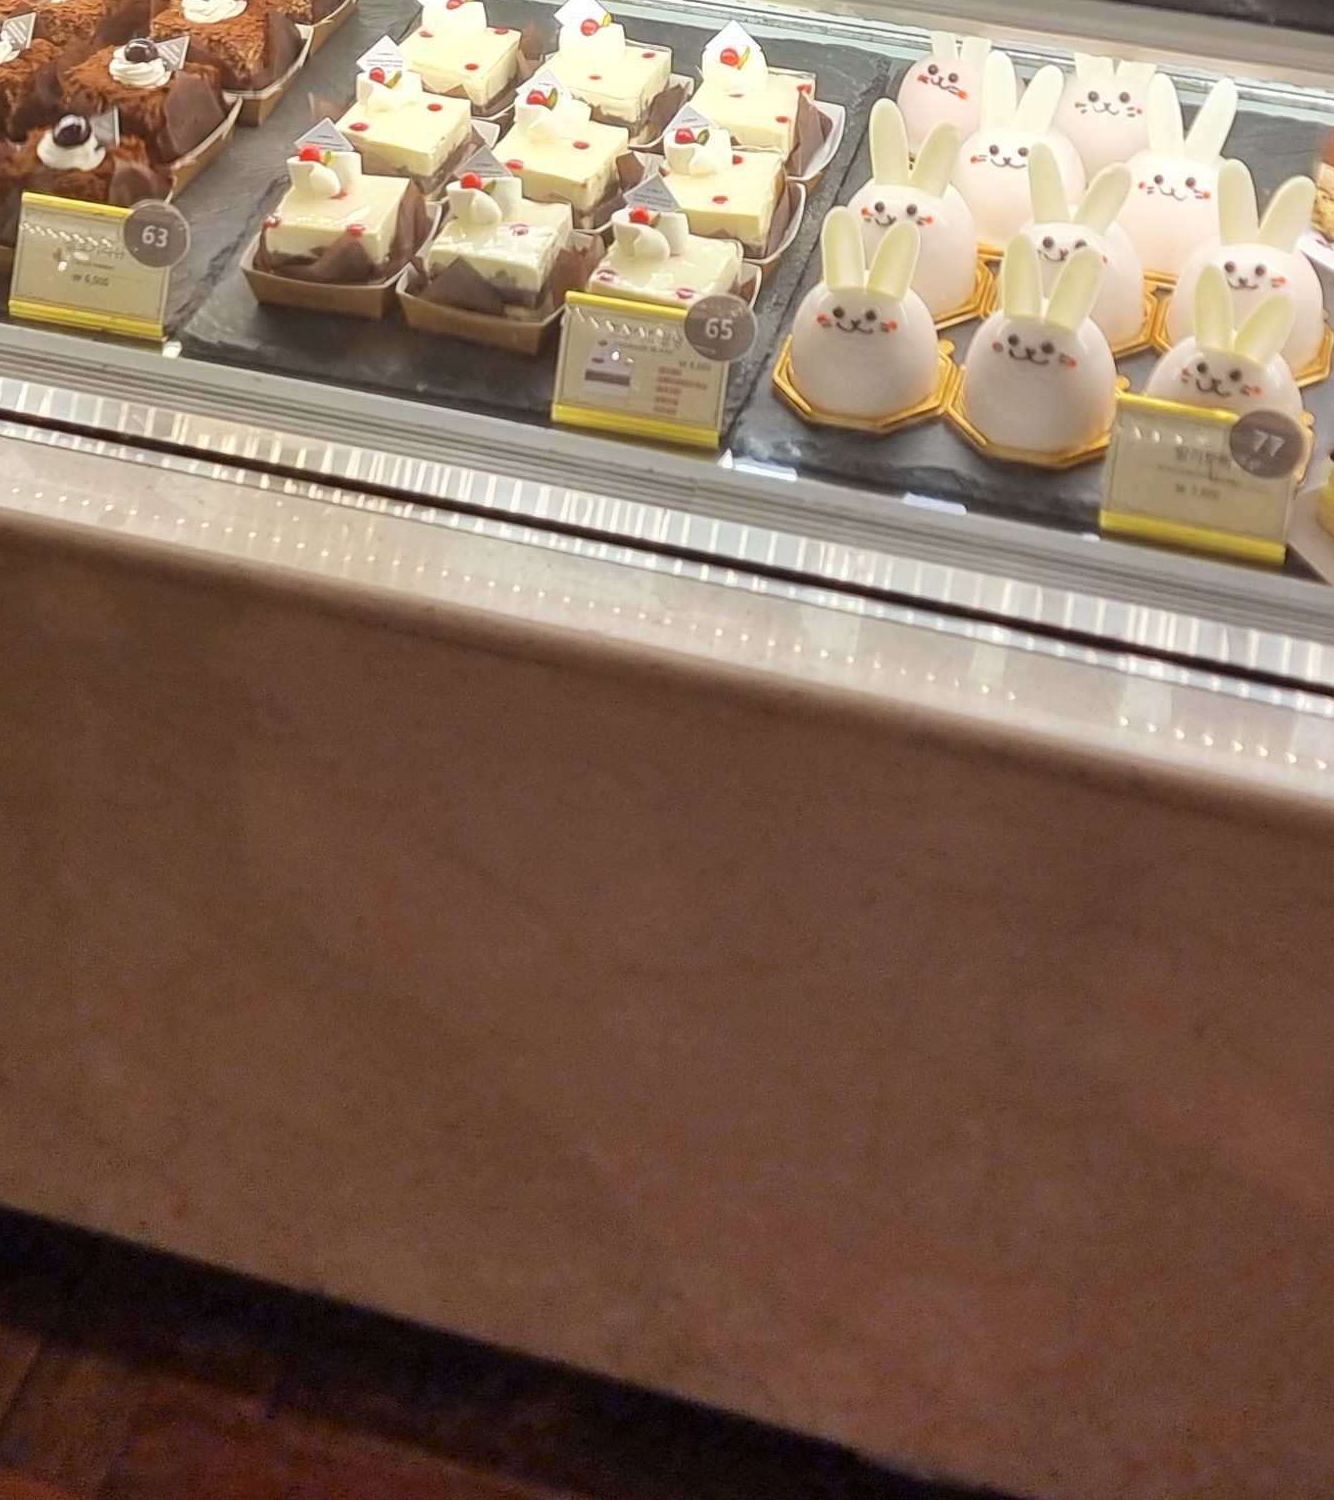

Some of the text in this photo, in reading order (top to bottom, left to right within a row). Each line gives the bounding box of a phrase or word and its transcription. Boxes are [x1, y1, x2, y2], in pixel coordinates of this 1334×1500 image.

[141, 225, 169, 248] 63
[704, 317, 734, 340] 65
[1252, 428, 1286, 457] 77
